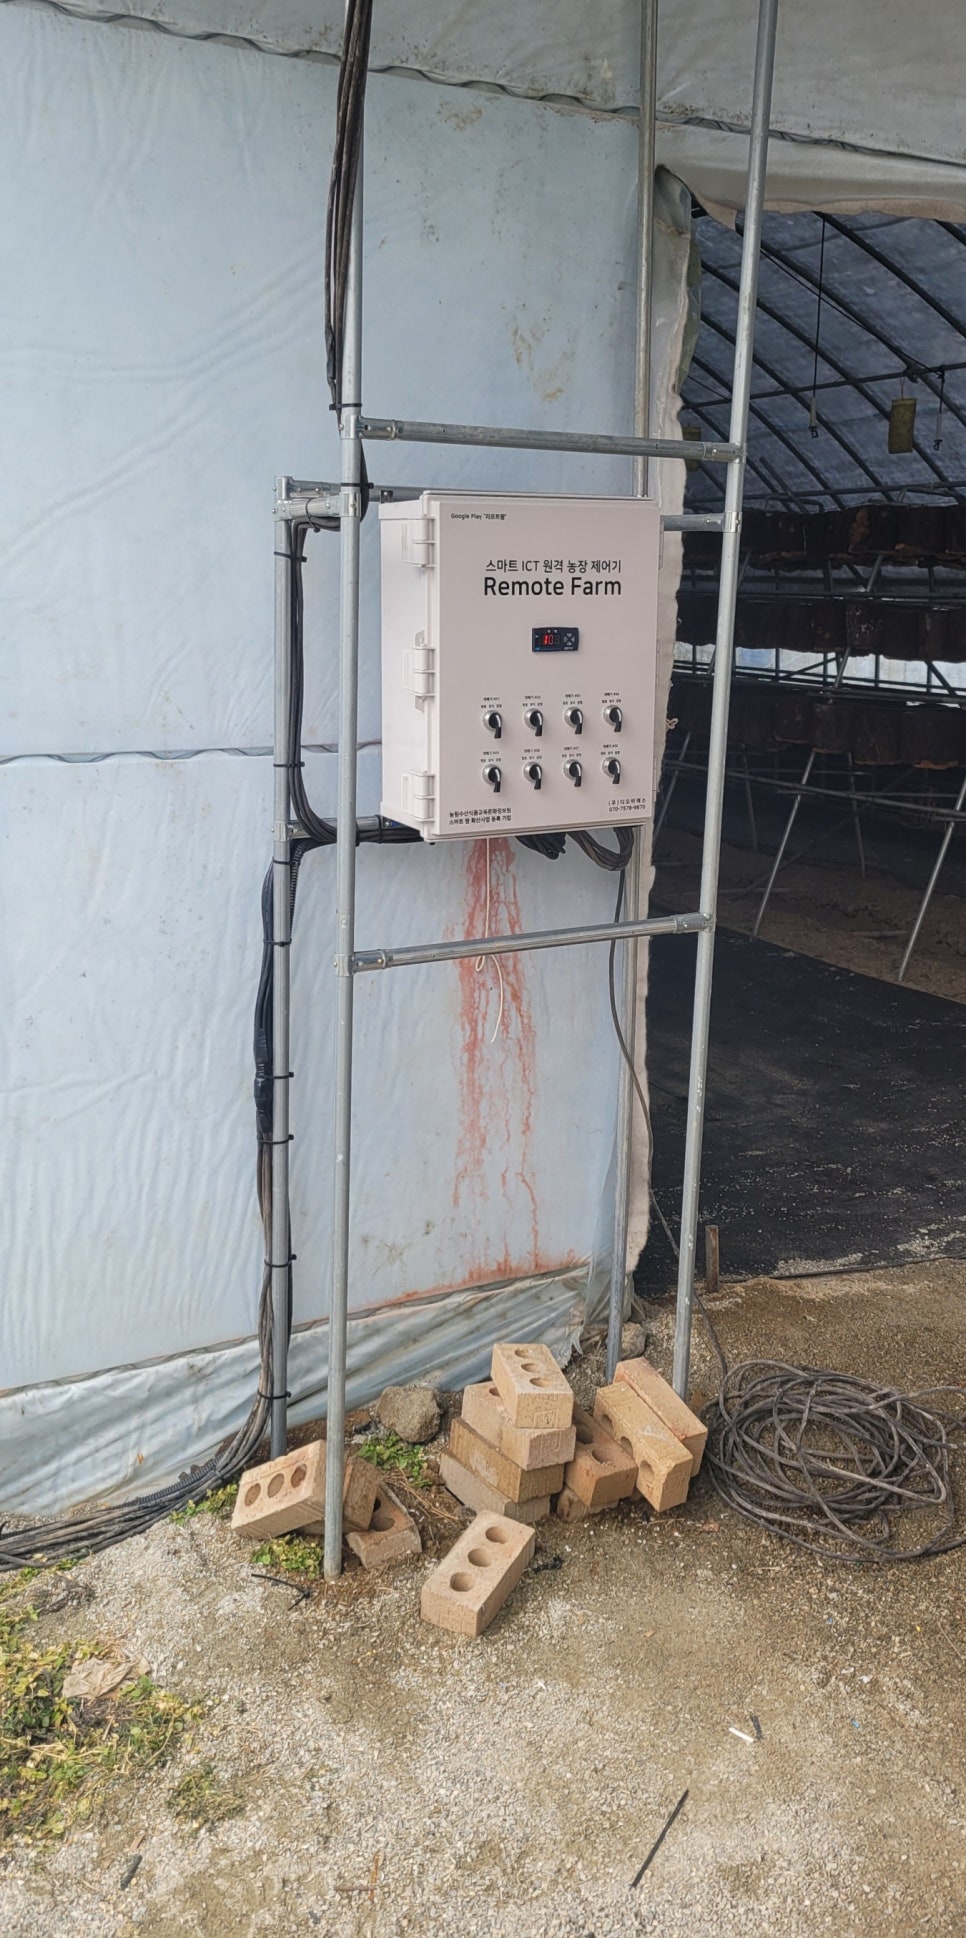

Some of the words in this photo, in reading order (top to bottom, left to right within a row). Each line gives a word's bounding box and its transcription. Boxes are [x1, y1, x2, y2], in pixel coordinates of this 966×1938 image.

[450, 512, 470, 521] Google
[471, 513, 482, 521] Play
[485, 559, 519, 573] 스마트
[521, 560, 540, 572] ICT
[543, 559, 564, 573] 원격
[567, 559, 588, 574] 농장
[590, 559, 621, 574] 제어기
[484, 576, 565, 596] Remote
[571, 576, 622, 596] Farm
